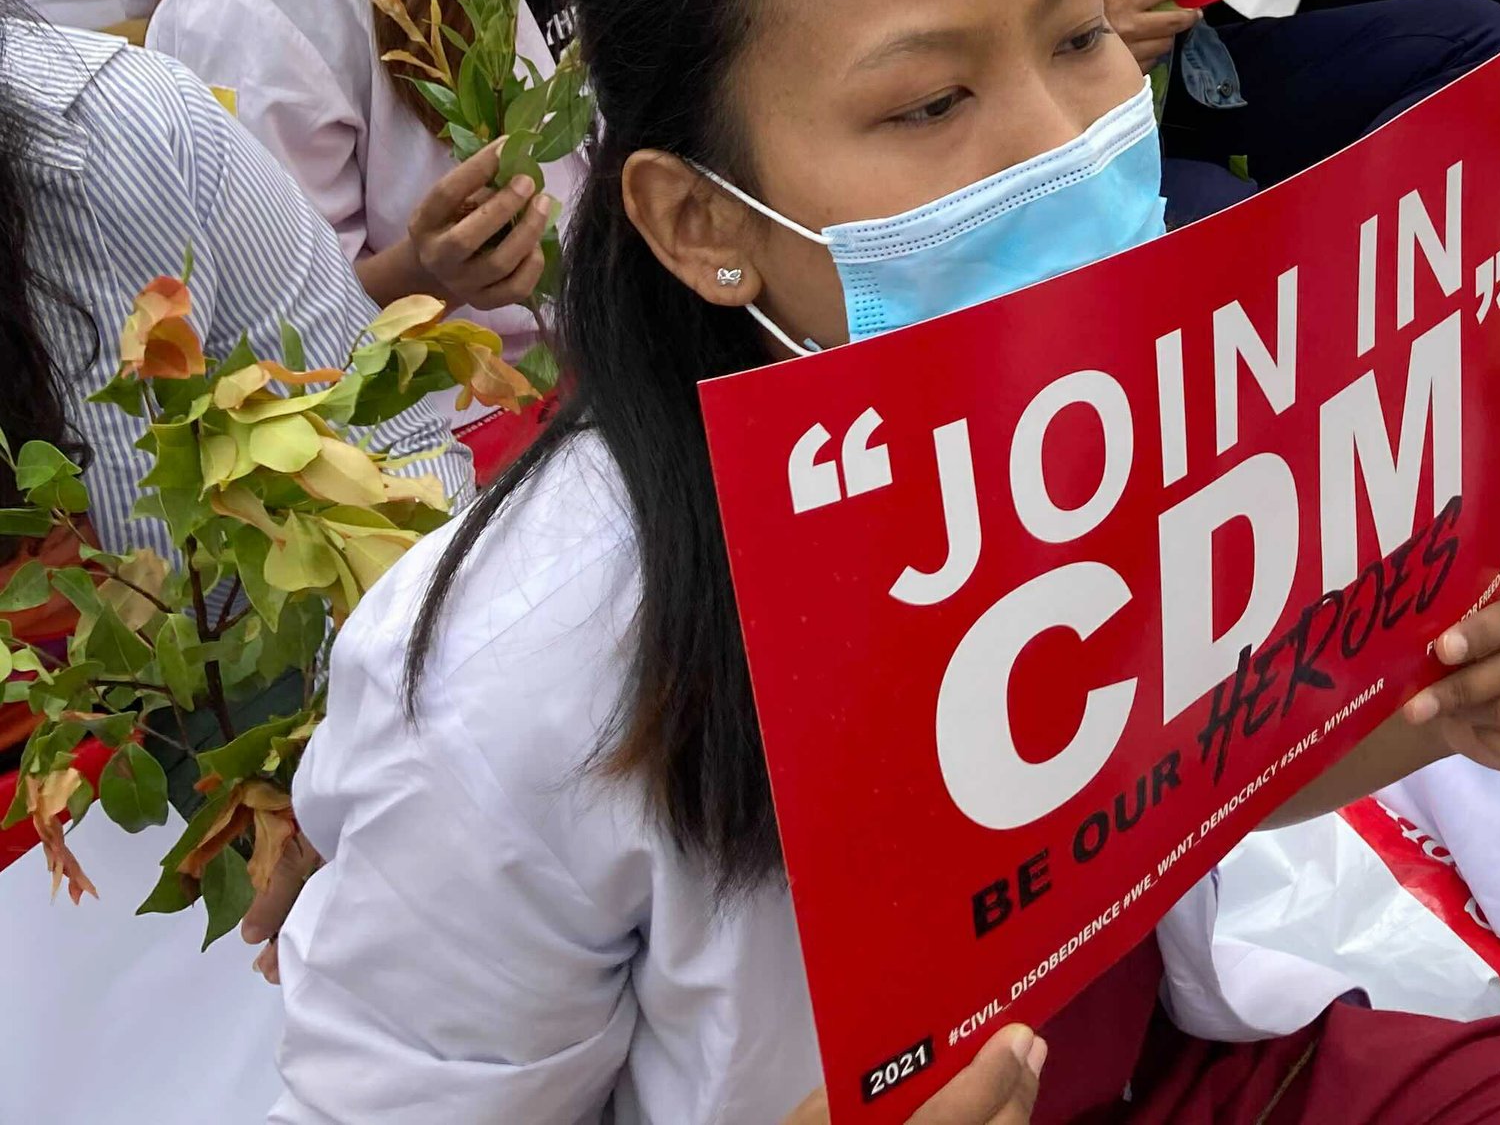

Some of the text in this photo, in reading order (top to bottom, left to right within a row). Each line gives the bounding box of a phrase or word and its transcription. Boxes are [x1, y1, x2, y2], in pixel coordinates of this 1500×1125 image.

[788, 160, 1464, 606] “JOIN IN
[868, 1045, 930, 1098] 2021
[948, 900, 1122, 1047] #CIVIL_DISOBEDIENCE
[1122, 762, 1280, 911] #WE_WANT_DEMOCRACY
[1280, 676, 1386, 771] #SAVE_MYANMAR
[971, 494, 1464, 941] BE OUR HEROES
